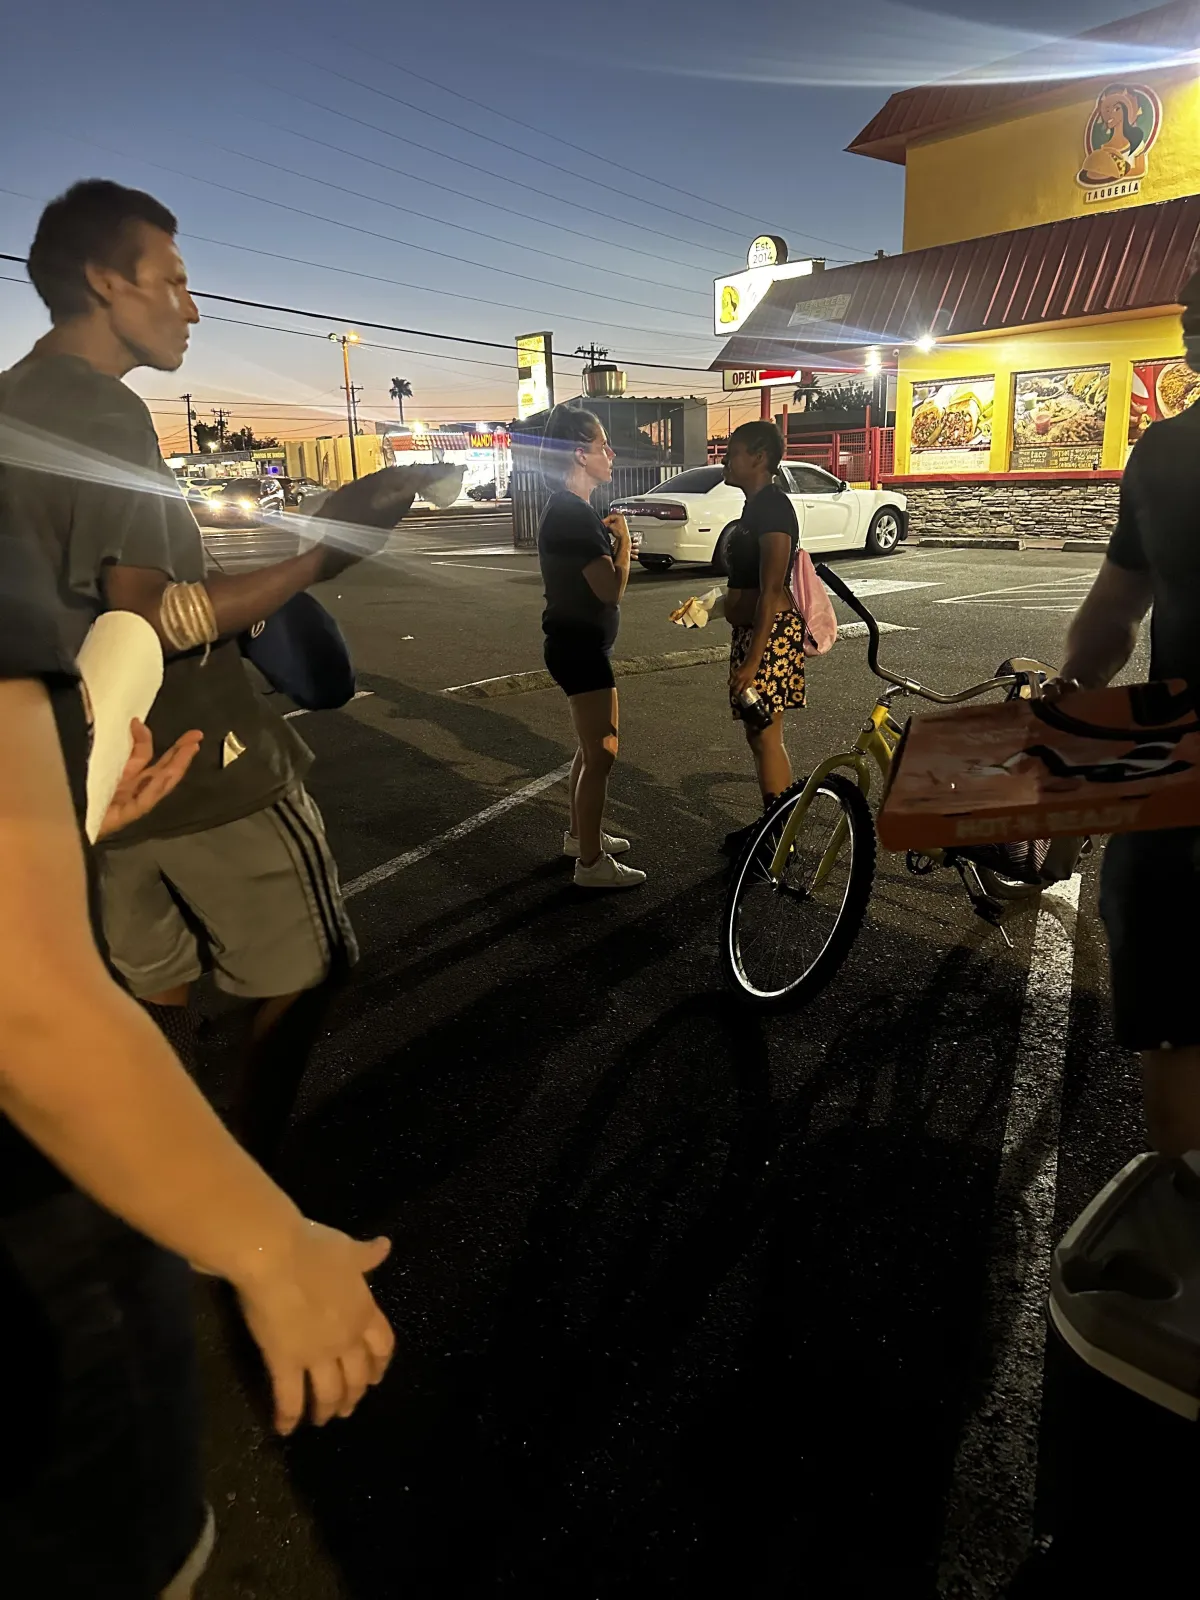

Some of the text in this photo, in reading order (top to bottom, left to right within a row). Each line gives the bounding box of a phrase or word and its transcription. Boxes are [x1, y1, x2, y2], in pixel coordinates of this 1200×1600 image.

[1087, 182, 1139, 200] TAQUERÍA
[756, 242, 771, 252] Est.
[753, 252, 773, 264] 2014
[732, 371, 756, 385] OPEN
